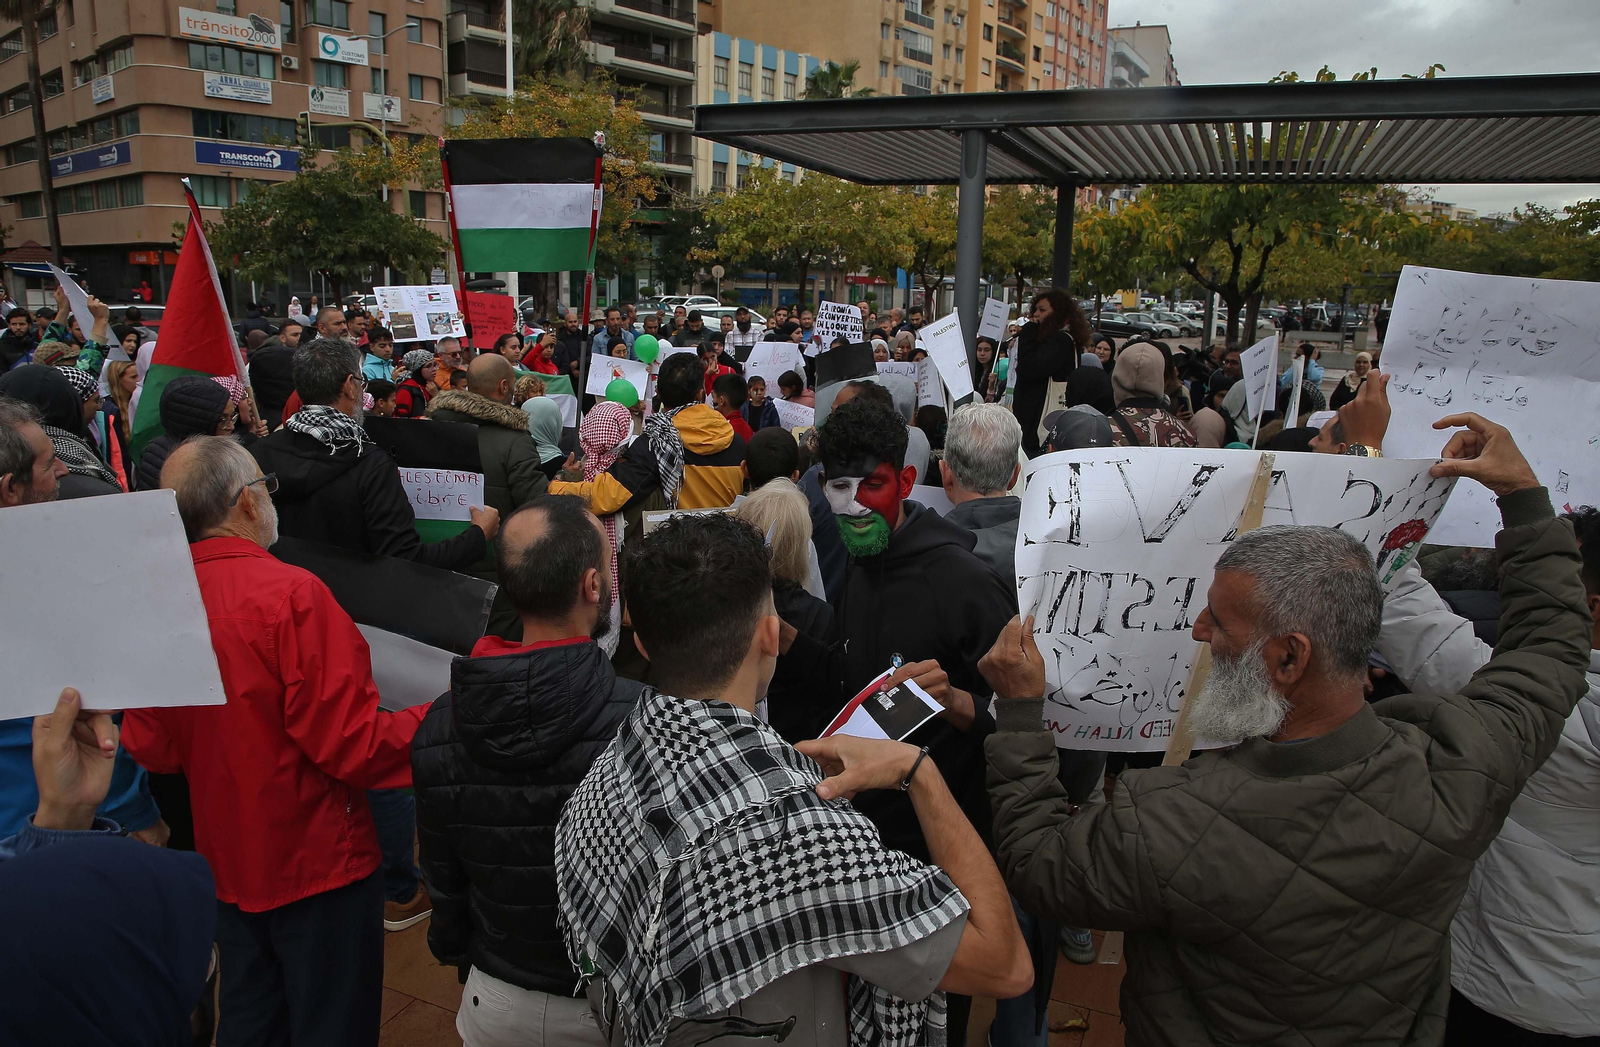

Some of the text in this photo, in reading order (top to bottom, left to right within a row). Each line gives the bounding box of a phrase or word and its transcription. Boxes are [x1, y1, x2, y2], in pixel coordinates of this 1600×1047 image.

[220, 75, 242, 86] ARNAL
[219, 151, 272, 163] TRANSCOMA
[821, 303, 851, 315] LA IRONÍA
[817, 320, 824, 328] EN
[836, 323, 848, 331] QUE
[932, 321, 957, 338] PALESTINA
